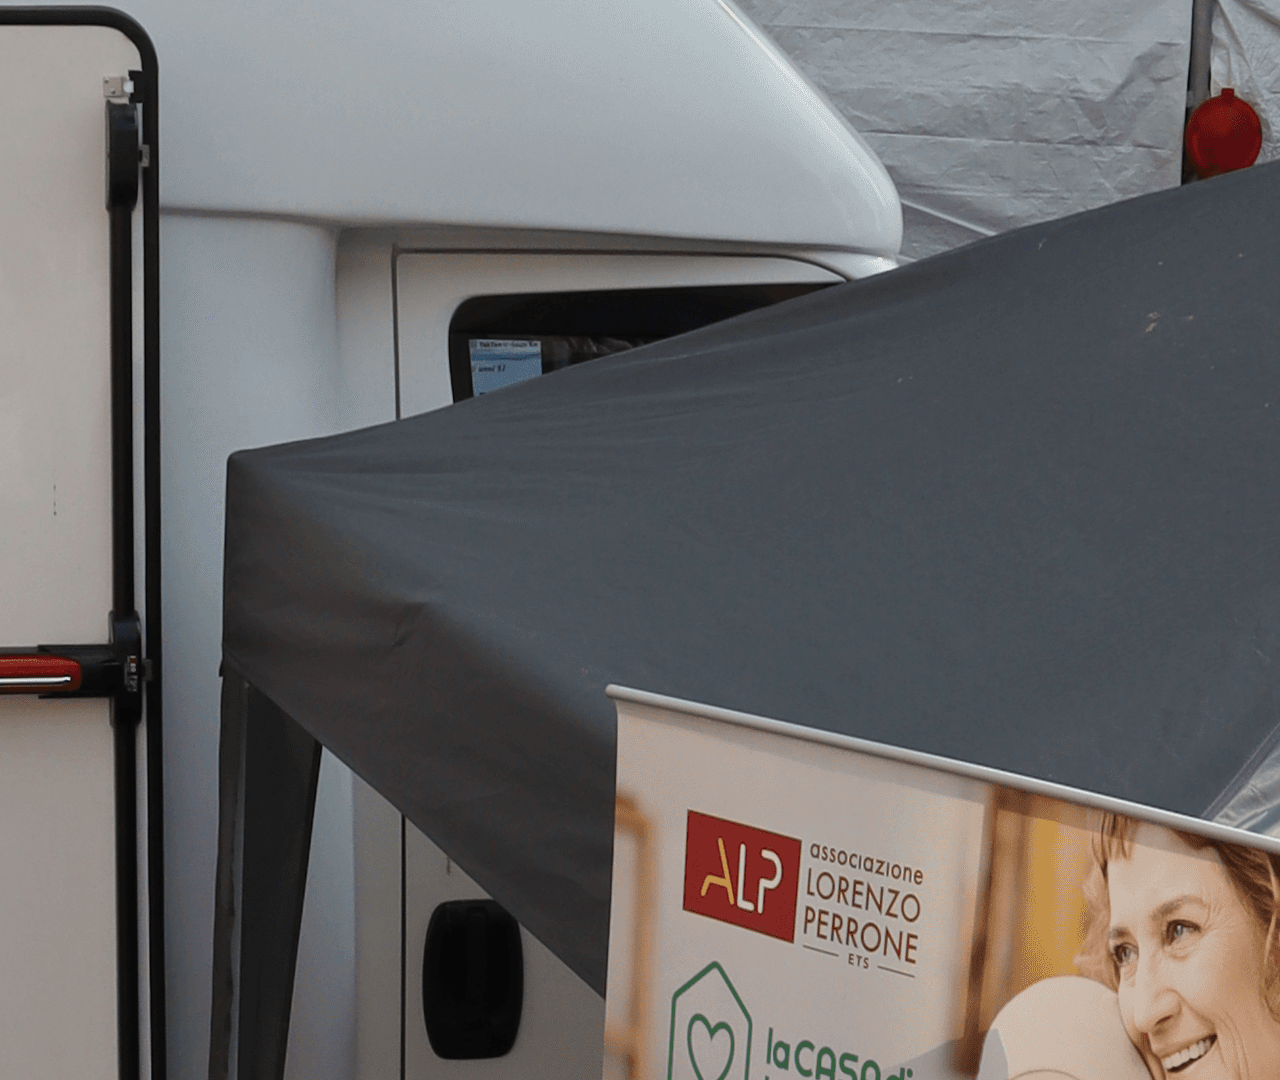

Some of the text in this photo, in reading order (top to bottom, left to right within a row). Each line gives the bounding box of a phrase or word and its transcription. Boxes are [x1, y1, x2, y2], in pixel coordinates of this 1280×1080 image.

[701, 837, 783, 914] ALP
[810, 843, 923, 886] associazione
[806, 867, 921, 923] LORENZO
[803, 905, 919, 965] PERRONE
[847, 953, 870, 970] ETS
